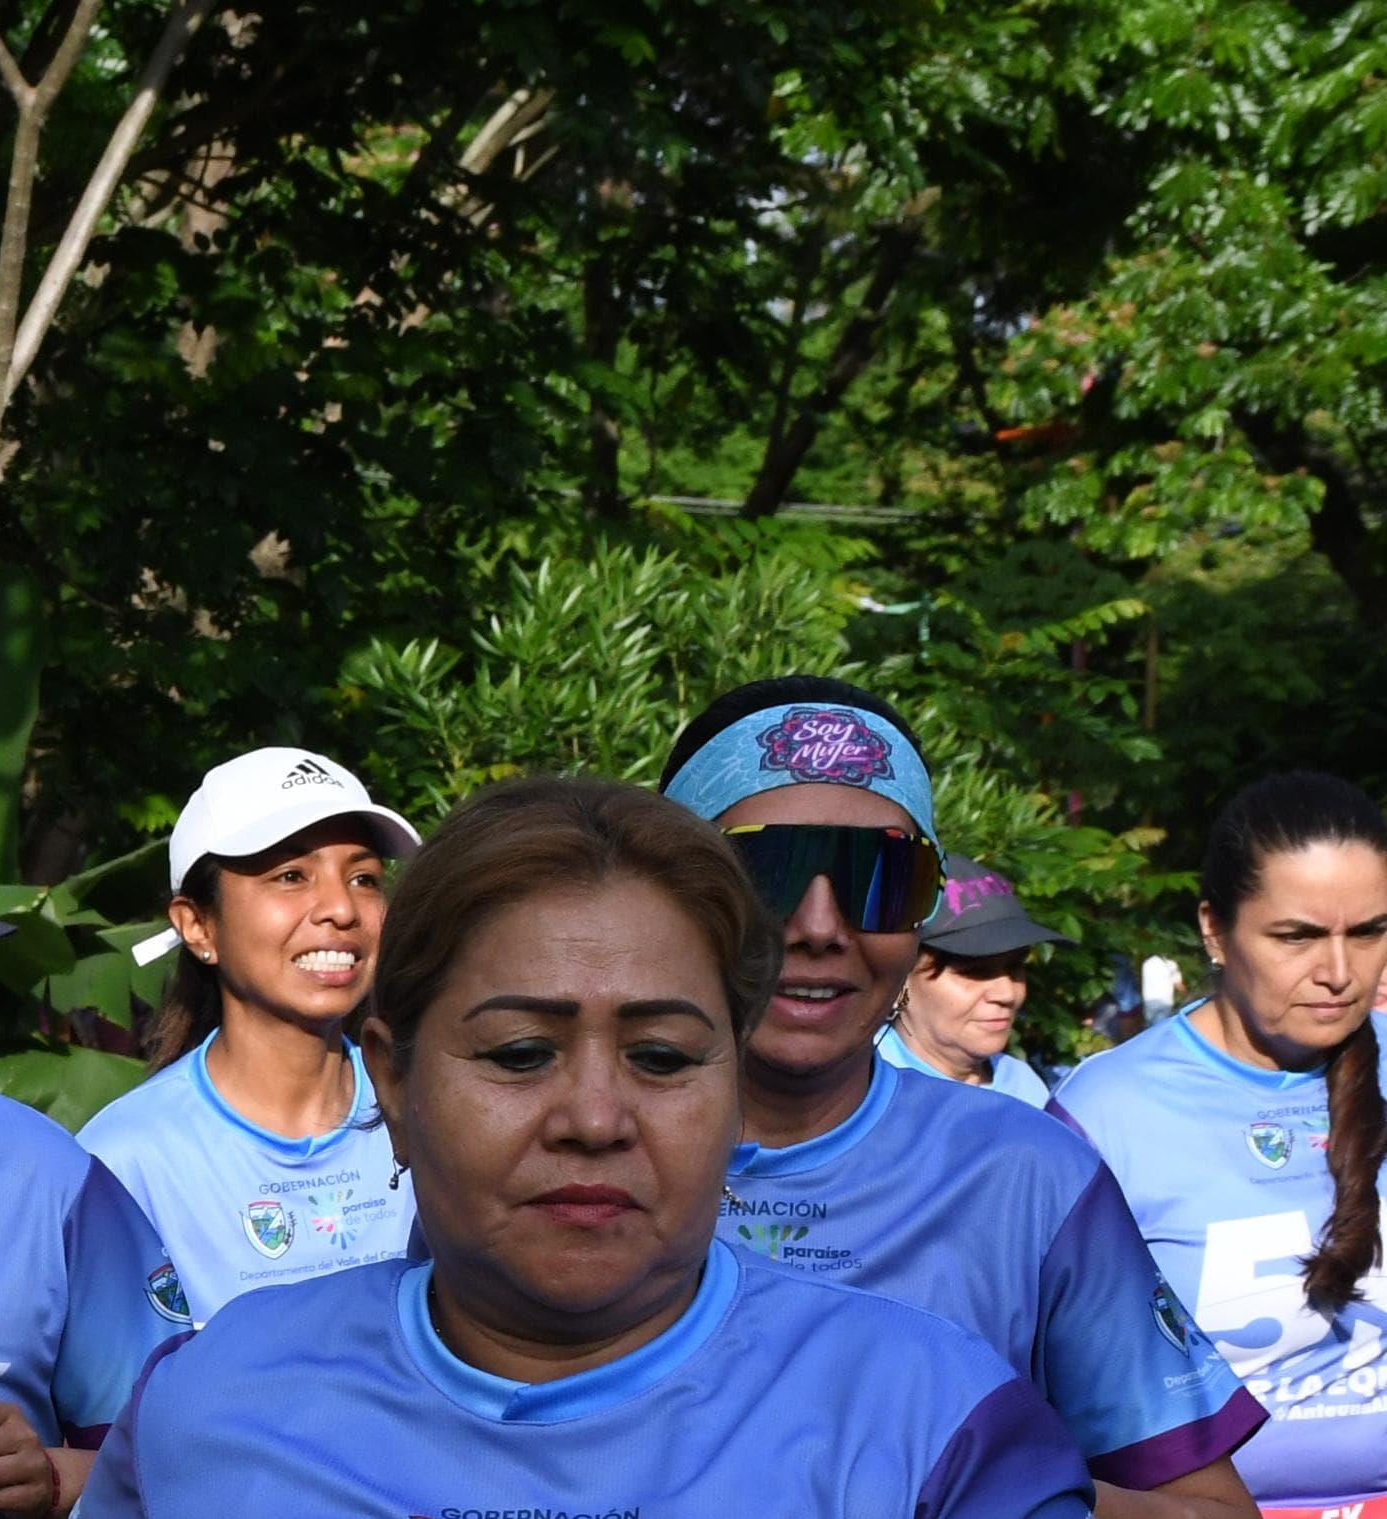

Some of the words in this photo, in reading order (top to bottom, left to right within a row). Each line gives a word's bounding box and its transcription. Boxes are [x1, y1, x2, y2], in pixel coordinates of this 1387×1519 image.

[792, 719, 855, 743] Soy
[259, 1168, 361, 1196] GOBERNACIÓN
[342, 1197, 387, 1216] paraíso
[365, 1207, 397, 1222] todos
[783, 1245, 852, 1259] paraíso
[240, 1263, 316, 1281] Departamento
[337, 1254, 361, 1268] Valle
[363, 1252, 379, 1265] del
[811, 1257, 863, 1273] todos
